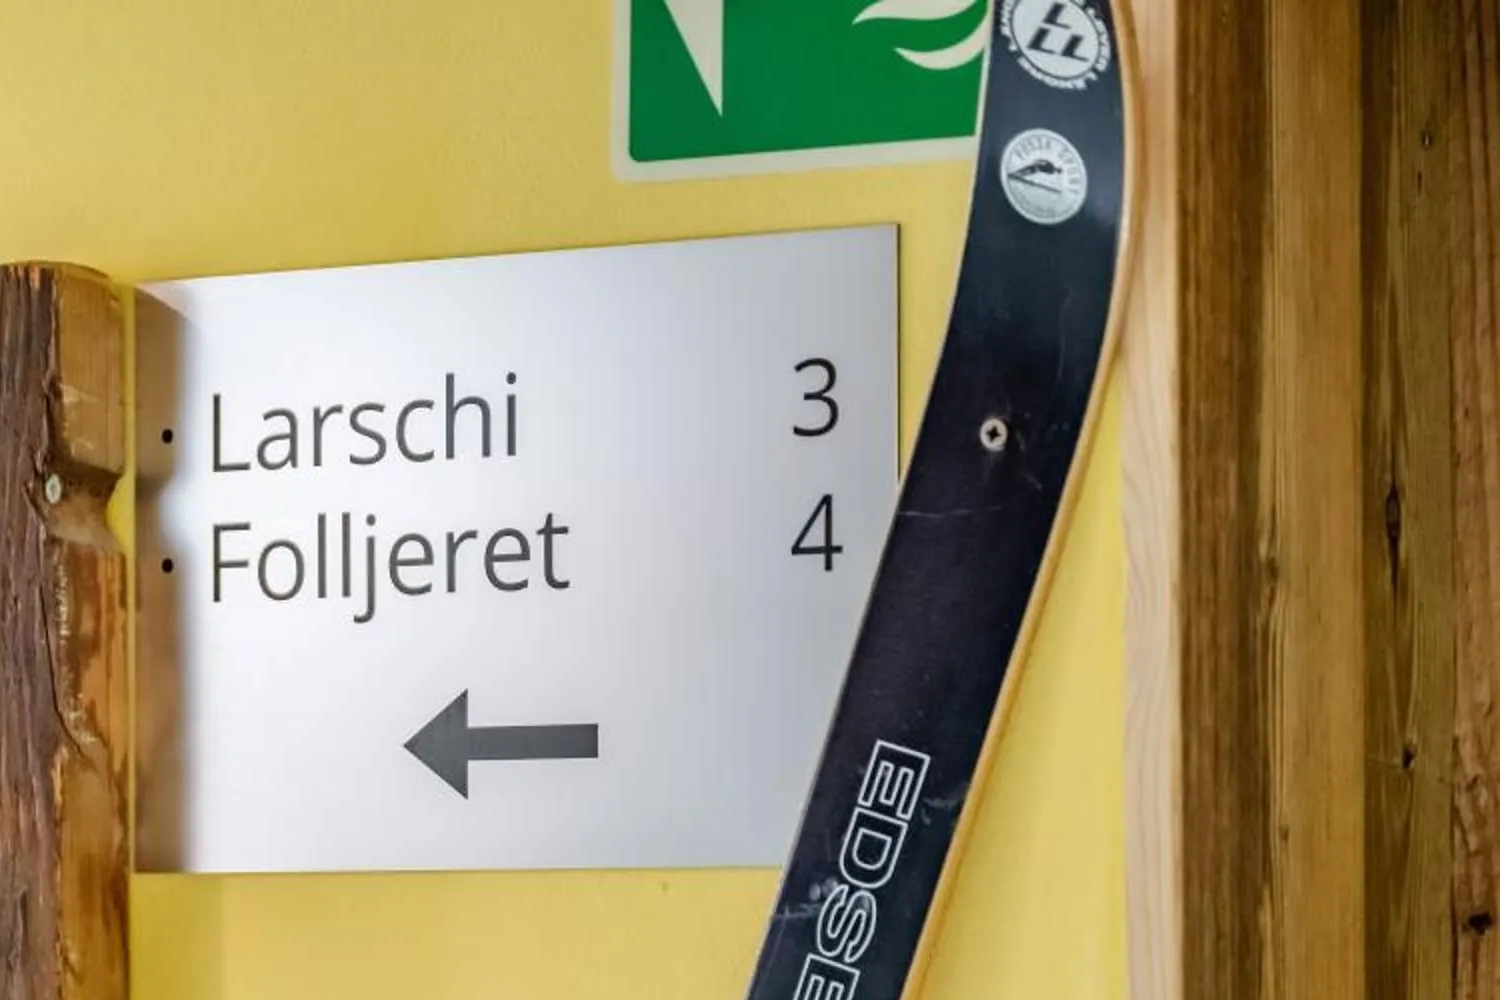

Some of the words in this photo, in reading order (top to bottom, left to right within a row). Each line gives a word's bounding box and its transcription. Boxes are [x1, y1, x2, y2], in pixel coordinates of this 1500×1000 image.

[211, 370, 519, 473] Larschi
[791, 356, 841, 438] 3
[211, 511, 571, 625] Folljeret
[790, 493, 844, 573] 4
